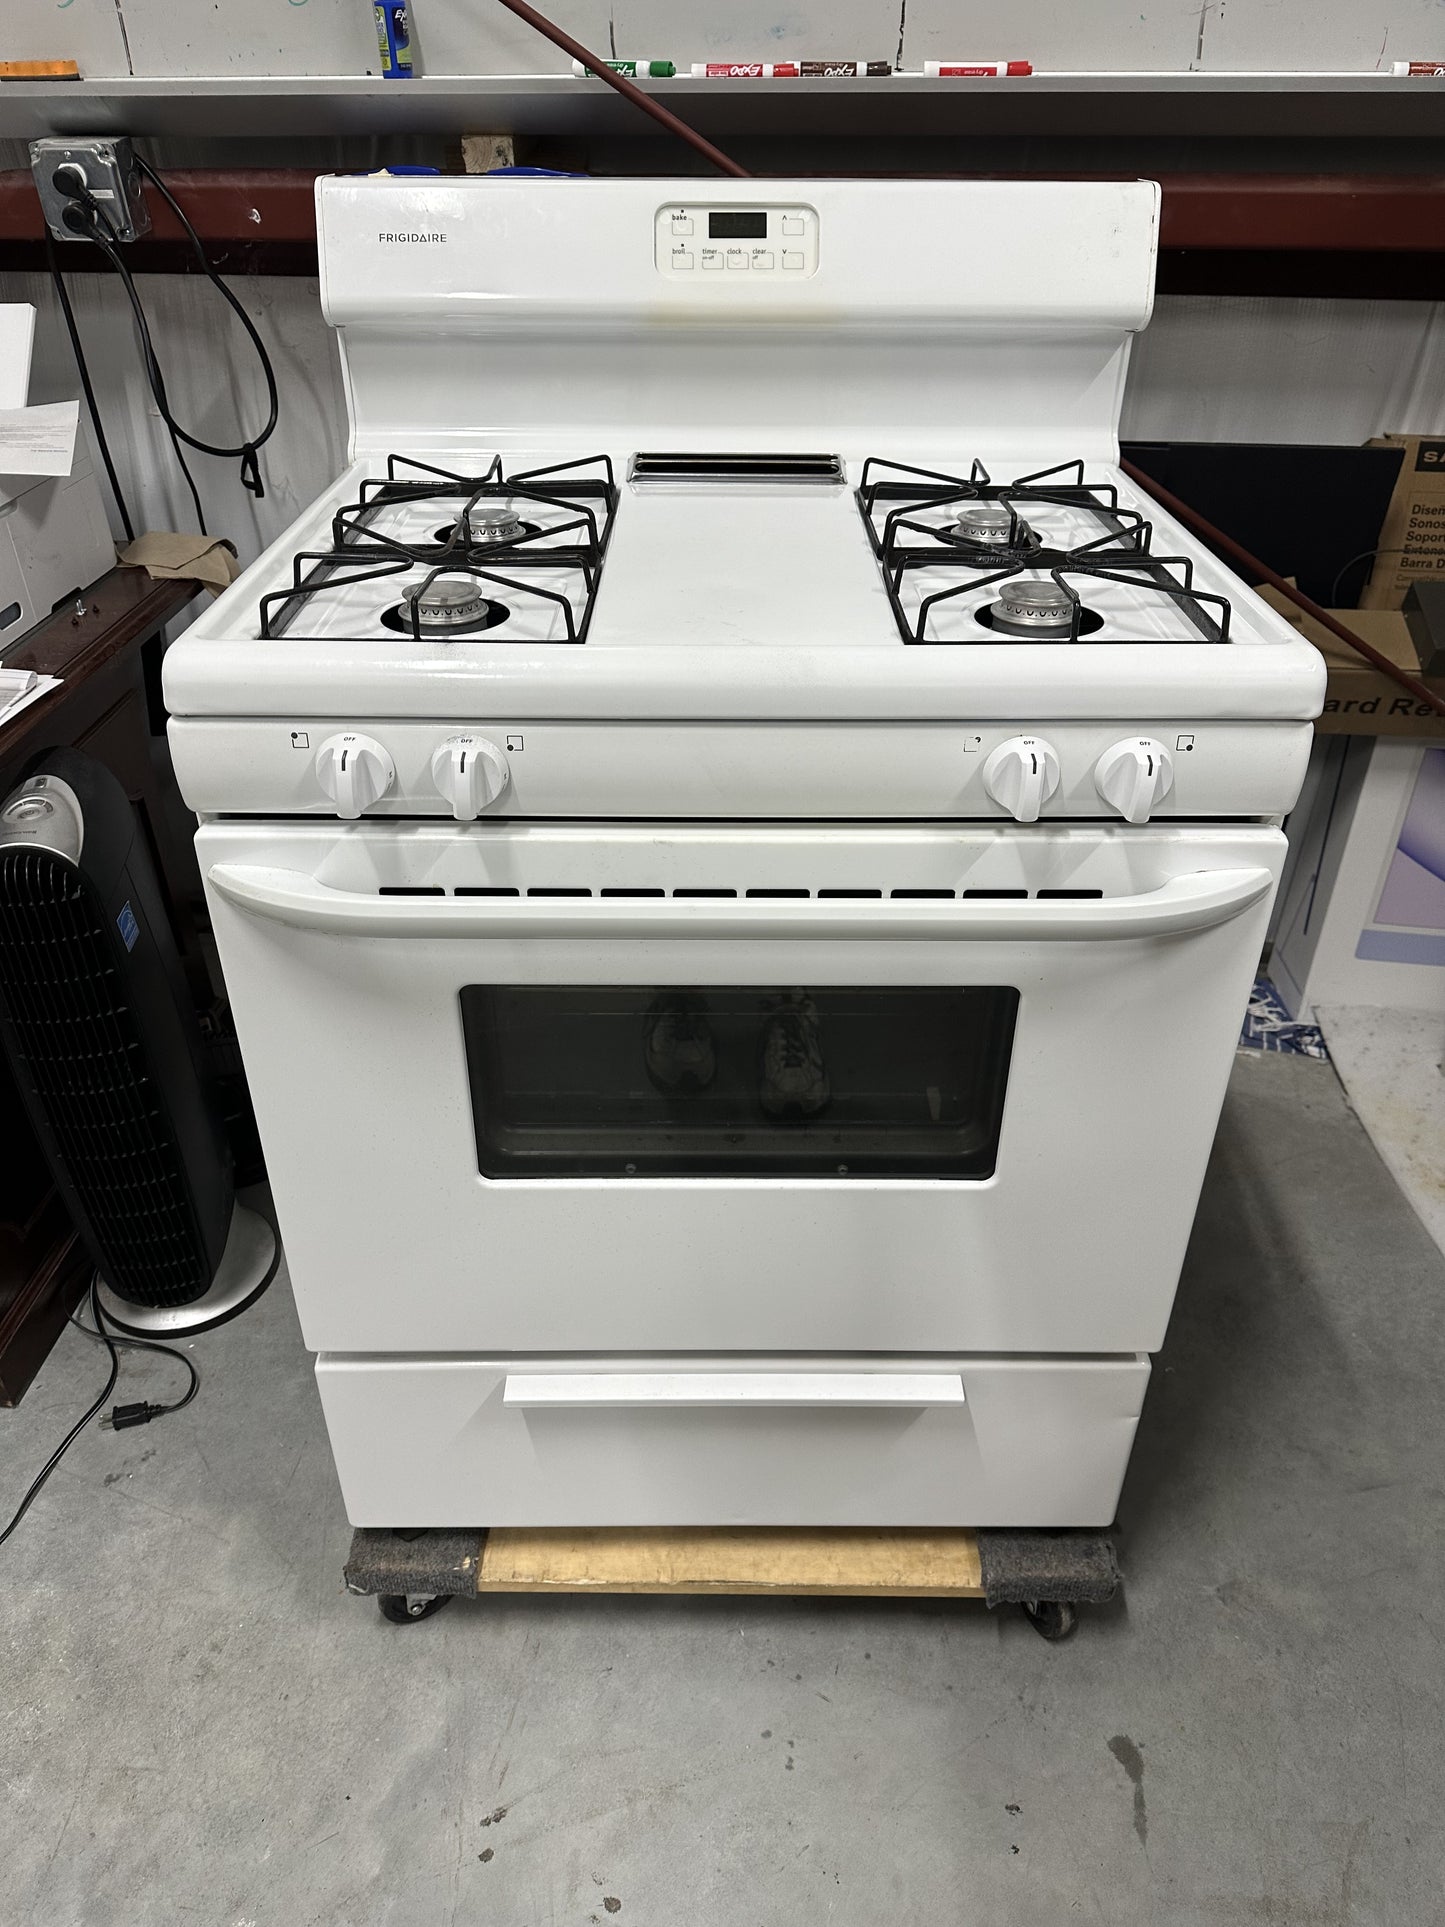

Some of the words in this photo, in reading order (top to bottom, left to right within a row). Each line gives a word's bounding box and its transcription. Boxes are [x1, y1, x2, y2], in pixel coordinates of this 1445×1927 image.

[730, 64, 761, 76] EXPO
[824, 64, 854, 77] EXPO
[672, 213, 688, 221] bake
[378, 233, 447, 243] FRIGIDAIRE
[672, 247, 686, 255] broil
[702, 247, 718, 255] timer
[726, 247, 742, 255] clock
[752, 247, 767, 255] clear
[1408, 517, 1445, 529] Sonos
[1405, 531, 1445, 544] Sopor
[1400, 557, 1433, 568] Barra
[1388, 698, 1445, 717] Re
